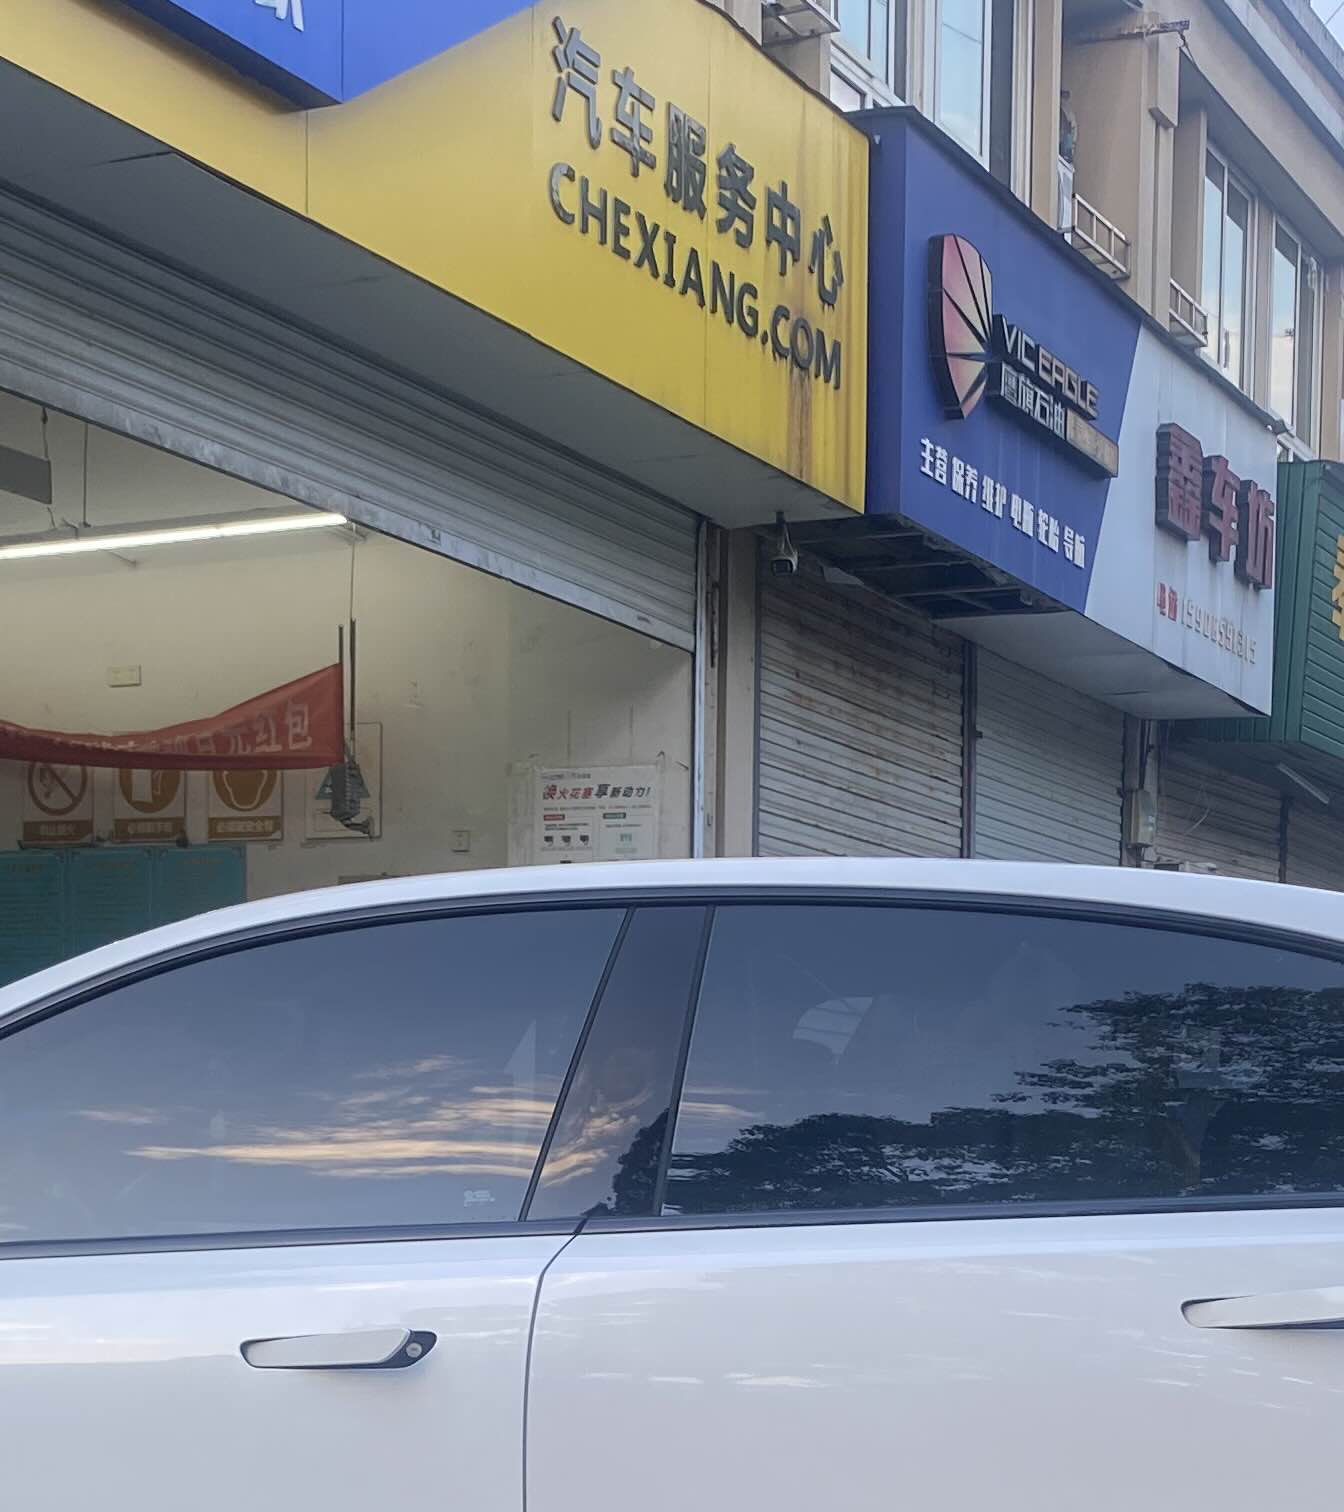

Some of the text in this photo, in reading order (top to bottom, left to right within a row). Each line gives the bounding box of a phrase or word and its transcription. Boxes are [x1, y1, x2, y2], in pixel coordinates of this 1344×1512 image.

[551, 15, 844, 308] 汽车服务中心
[548, 162, 843, 390] CHEXIANG.COM
[920, 437, 948, 485] 主营
[951, 456, 978, 503] 保养
[1037, 508, 1060, 553] 轮胎
[1155, 422, 1274, 592] 鑫车坊
